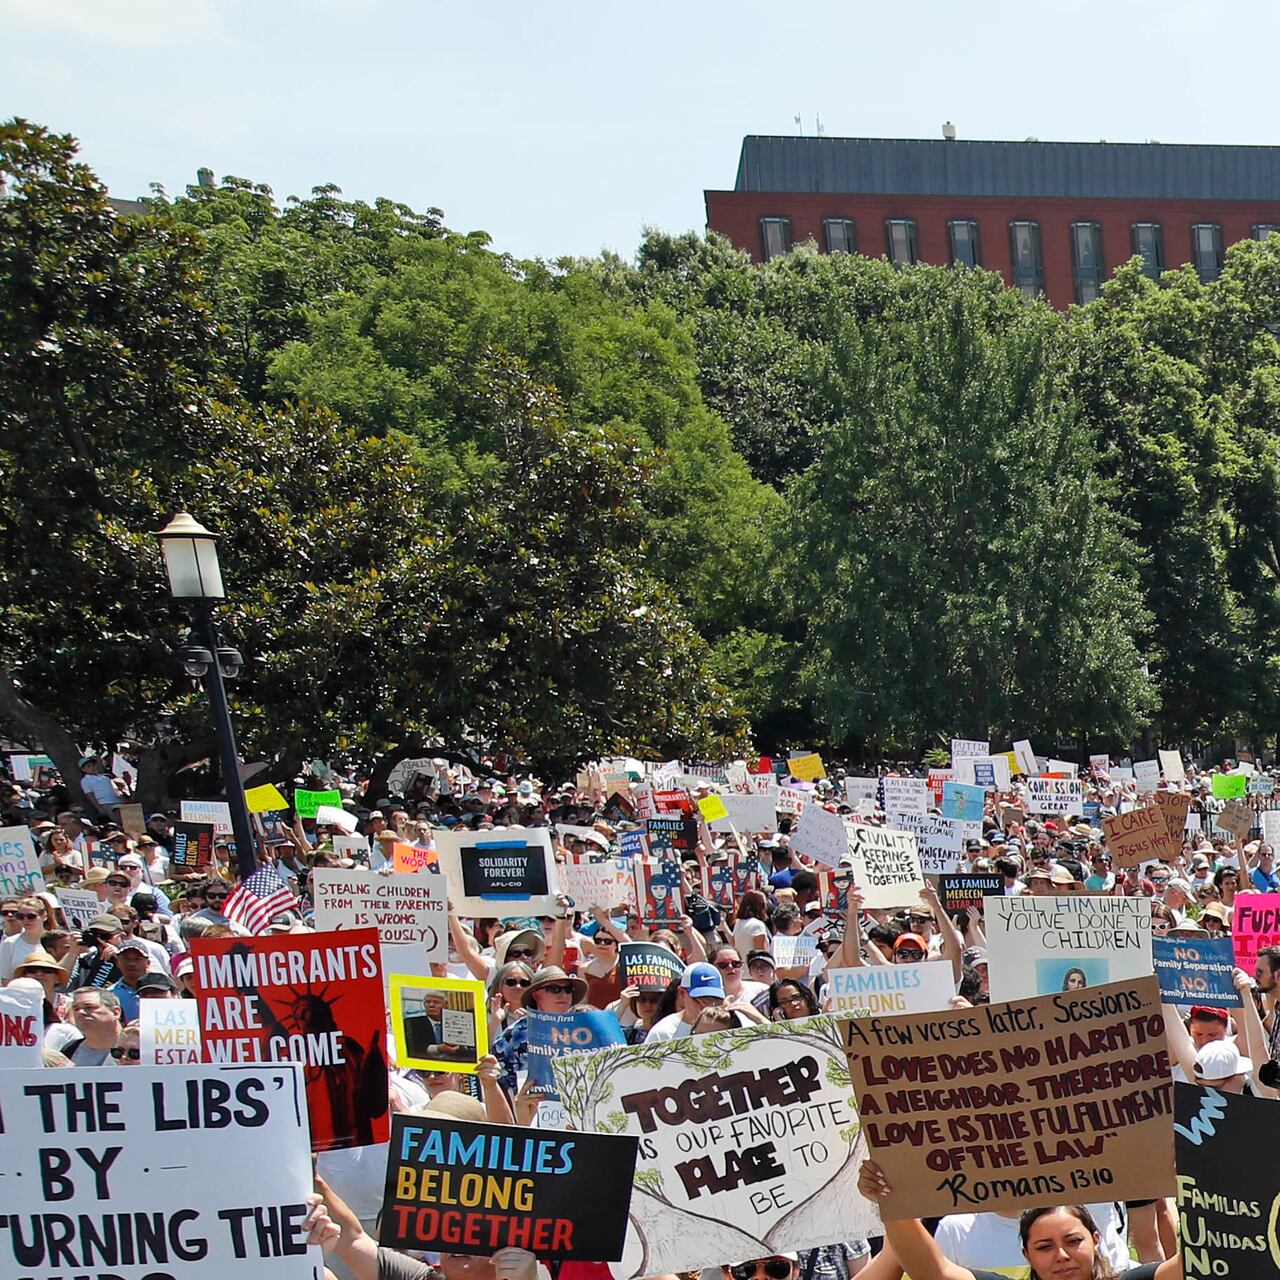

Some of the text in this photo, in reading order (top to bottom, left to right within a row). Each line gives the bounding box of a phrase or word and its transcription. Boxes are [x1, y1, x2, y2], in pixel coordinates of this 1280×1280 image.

[857, 828, 916, 848] CIVILITY
[862, 849, 910, 863] KEEPING
[479, 857, 528, 868] SOLIDARITY
[484, 868, 525, 878] FOREVER!
[866, 861, 914, 873] FAMILIES
[866, 872, 922, 886] TOGETHER
[319, 883, 430, 898] STEALNG CHILDREN
[324, 899, 444, 911] FROM THEIR PARENTS
[355, 913, 419, 925] IS WRONG.
[198, 942, 378, 990] IMMIGRANTS
[205, 995, 259, 1032] ARE
[847, 1021, 869, 1047] A
[870, 1019, 913, 1046] few
[915, 1018, 981, 1042] verses
[987, 1006, 1045, 1033] later,
[205, 1031, 346, 1066] WELCOME
[940, 1050, 998, 1081] DOES
[1000, 1047, 1041, 1074] NO
[1046, 1026, 1127, 1067] HARM
[1128, 1013, 1165, 1040] TO
[621, 1055, 822, 1134] TOGETHER
[860, 1049, 1171, 1116] A NEIGHBOR. THEREFORE
[24, 1076, 286, 1133] THE LIBS'
[867, 1082, 1174, 1149] LOVE IS THE FULFILLMENT
[676, 1125, 725, 1153] OUR
[730, 1100, 850, 1148] FAVORITE
[400, 1126, 574, 1176] FAMILIES
[674, 1140, 829, 1200] PLACE TO
[926, 1147, 965, 1172] OF
[963, 1143, 1029, 1169] THE
[39, 1146, 124, 1202] BY
[396, 1166, 535, 1211] BELONG
[936, 1172, 1065, 1207] Romans
[749, 1184, 793, 1215] BE
[1176, 1174, 1262, 1218] FAMILIAS
[218, 1205, 308, 1259] THE
[394, 1206, 574, 1251] TOGETHER
[1180, 1212, 1267, 1252] UNIDAS
